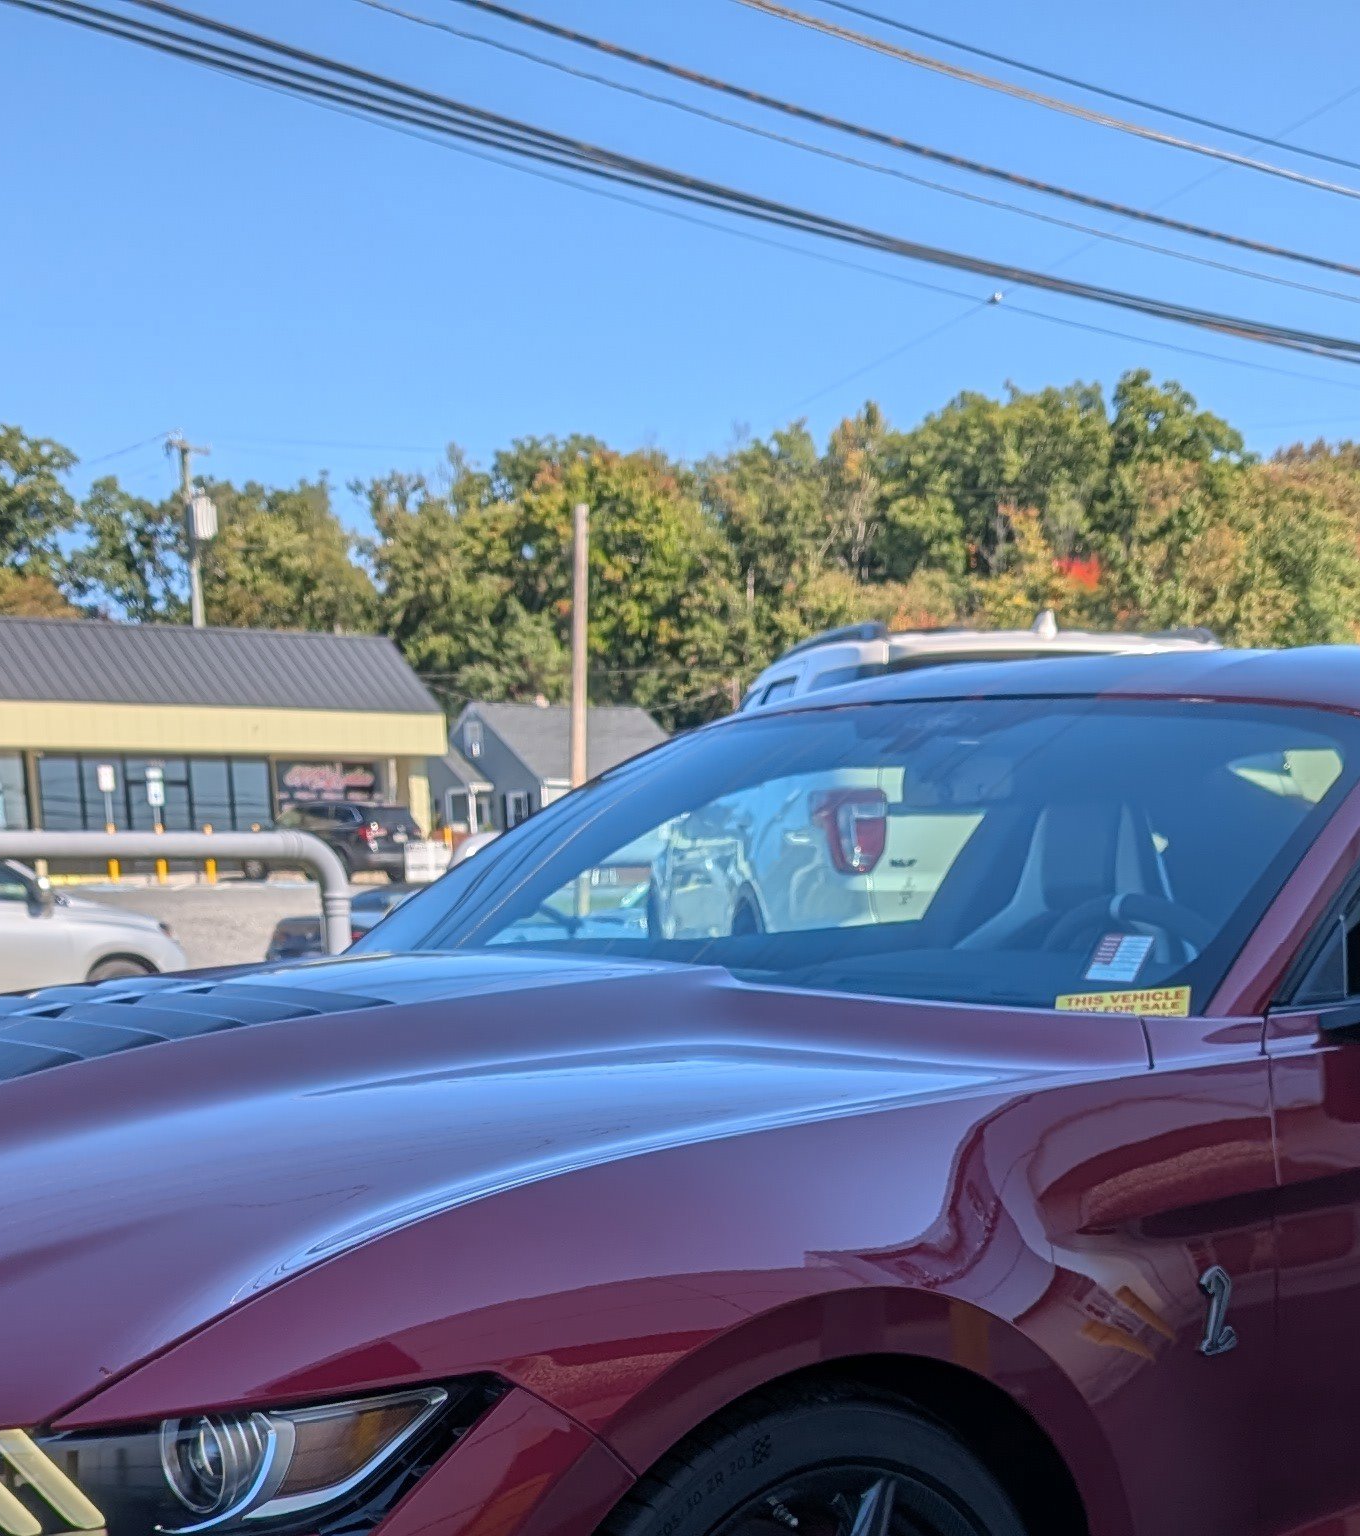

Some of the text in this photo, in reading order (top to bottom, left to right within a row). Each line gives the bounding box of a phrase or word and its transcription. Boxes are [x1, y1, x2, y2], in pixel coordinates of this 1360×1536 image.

[1066, 989, 1186, 1007] THIS VEHICLE
[1140, 1002, 1179, 1010] SALE
